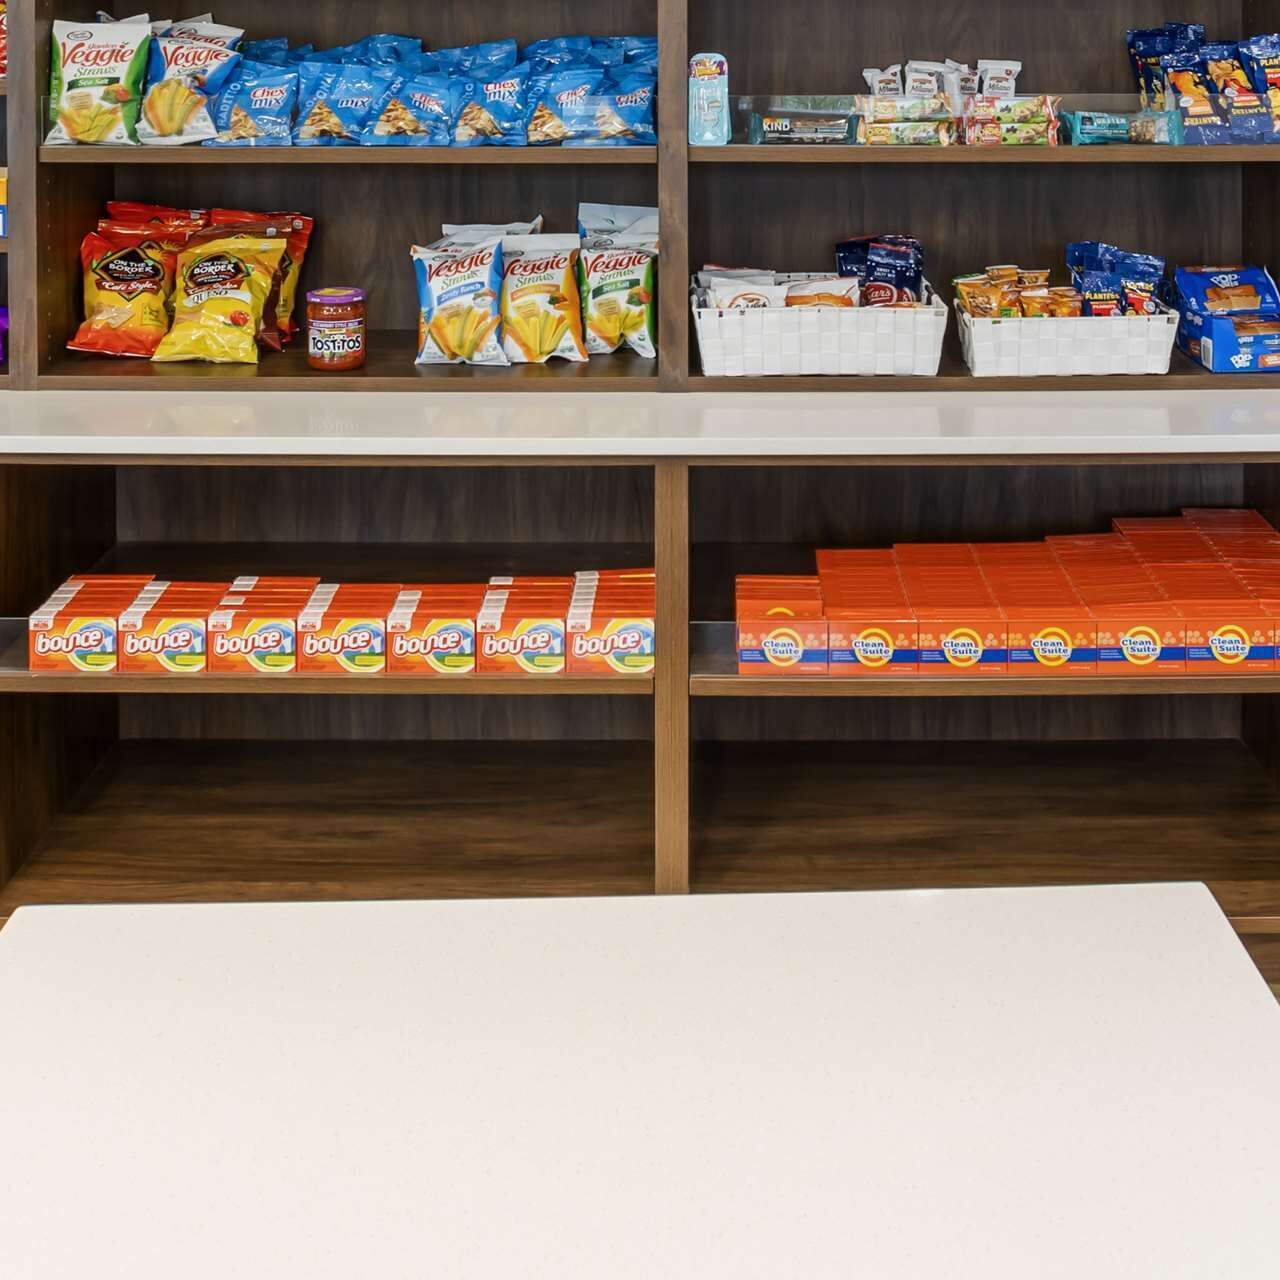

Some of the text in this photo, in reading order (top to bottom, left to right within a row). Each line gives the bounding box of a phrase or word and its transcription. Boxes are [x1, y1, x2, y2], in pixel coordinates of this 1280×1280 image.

[61, 41, 135, 68] Veggie
[163, 45, 229, 69] Veggie
[251, 87, 285, 99] Chex
[762, 121, 791, 131] KIND
[108, 263, 154, 274] BORDER
[193, 263, 235, 275] BORDER
[427, 251, 493, 282] Veggie
[503, 255, 568, 280] Veggie
[583, 253, 650, 280] Veggie
[312, 335, 361, 351] TOSTITOS
[36, 630, 102, 653] bounce
[124, 631, 192, 655] bounce
[215, 631, 281, 654] bounce
[303, 632, 371, 655] bounce
[393, 631, 461, 655] bounce
[483, 632, 551, 655] bounce
[573, 631, 641, 655] bounce
[1032, 640, 1062, 648] Clean
[1121, 639, 1152, 647] Clean
[1210, 638, 1241, 646] Clean
[771, 648, 800, 656] Suite
[862, 648, 890, 656] Suite
[951, 648, 980, 656] Suite
[1040, 647, 1069, 655] Suite
[1129, 646, 1158, 654] Suite
[1218, 645, 1247, 653] Suite
